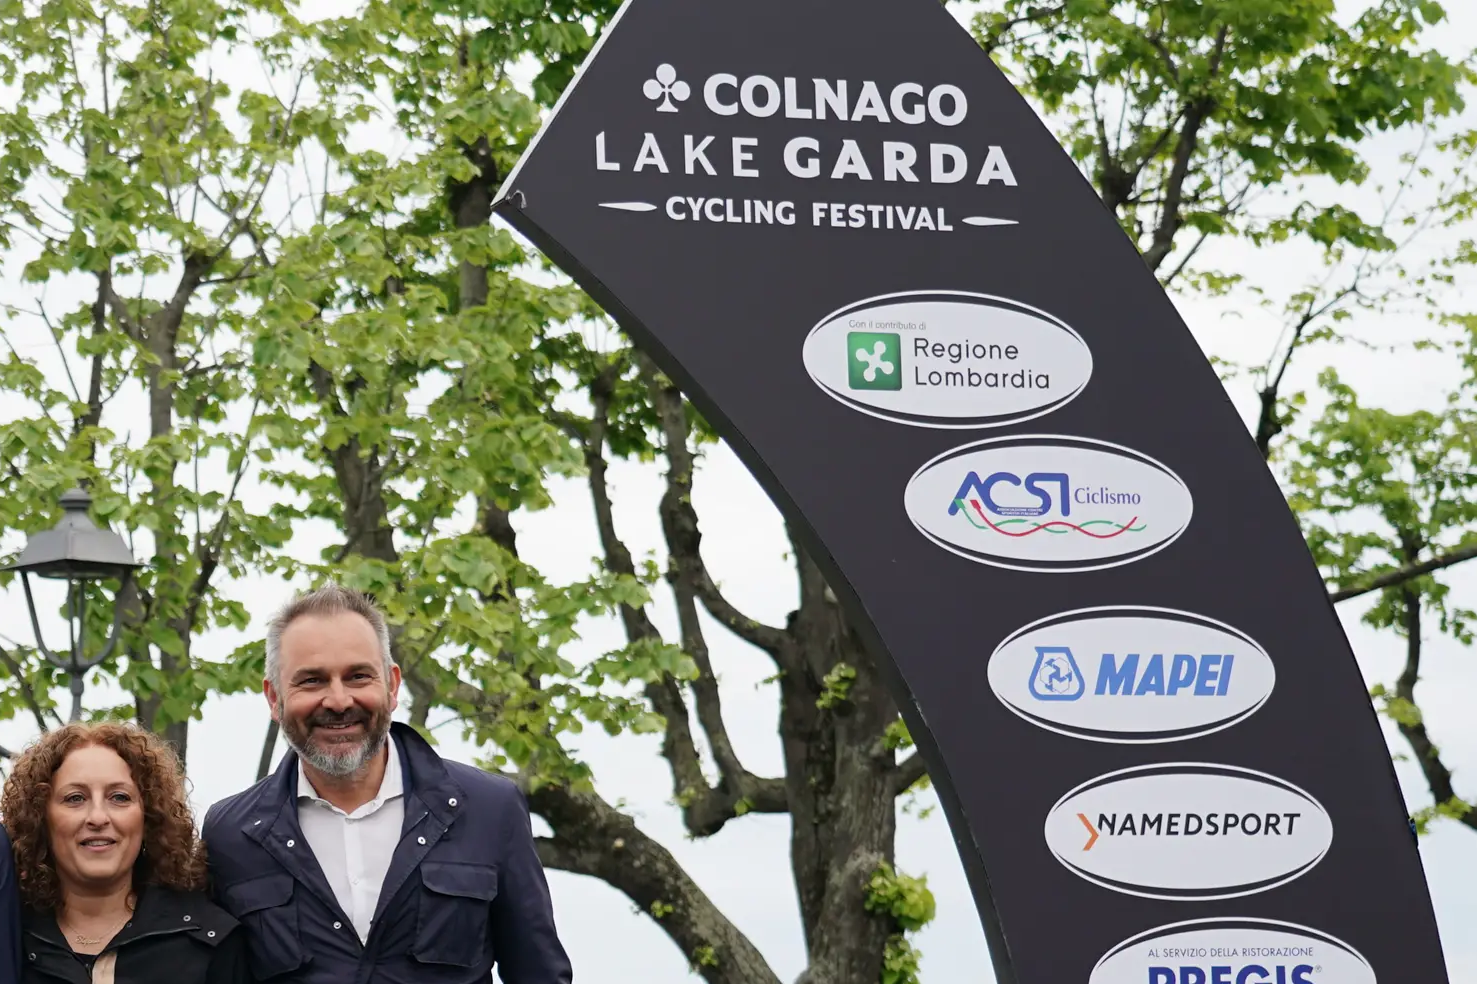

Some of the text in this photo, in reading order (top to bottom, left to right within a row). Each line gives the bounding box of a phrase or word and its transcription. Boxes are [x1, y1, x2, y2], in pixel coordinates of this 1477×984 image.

[703, 73, 968, 127] COLNAGO
[595, 131, 1018, 186] LAKE GARDA
[665, 196, 954, 232] CYCLING FESTIVAL
[849, 320, 867, 328] Con
[875, 321, 917, 330] contributo
[919, 322, 926, 330] di
[914, 338, 1019, 363] Regione
[915, 366, 1050, 389] Lombardia
[1075, 487, 1141, 505] Ciclismo
[1094, 654, 1235, 696] MAPEI
[1098, 813, 1301, 836] NAMEDSPORT
[1148, 947, 1314, 958] AL SERVIZIO DELLA RISTORAZIONE
